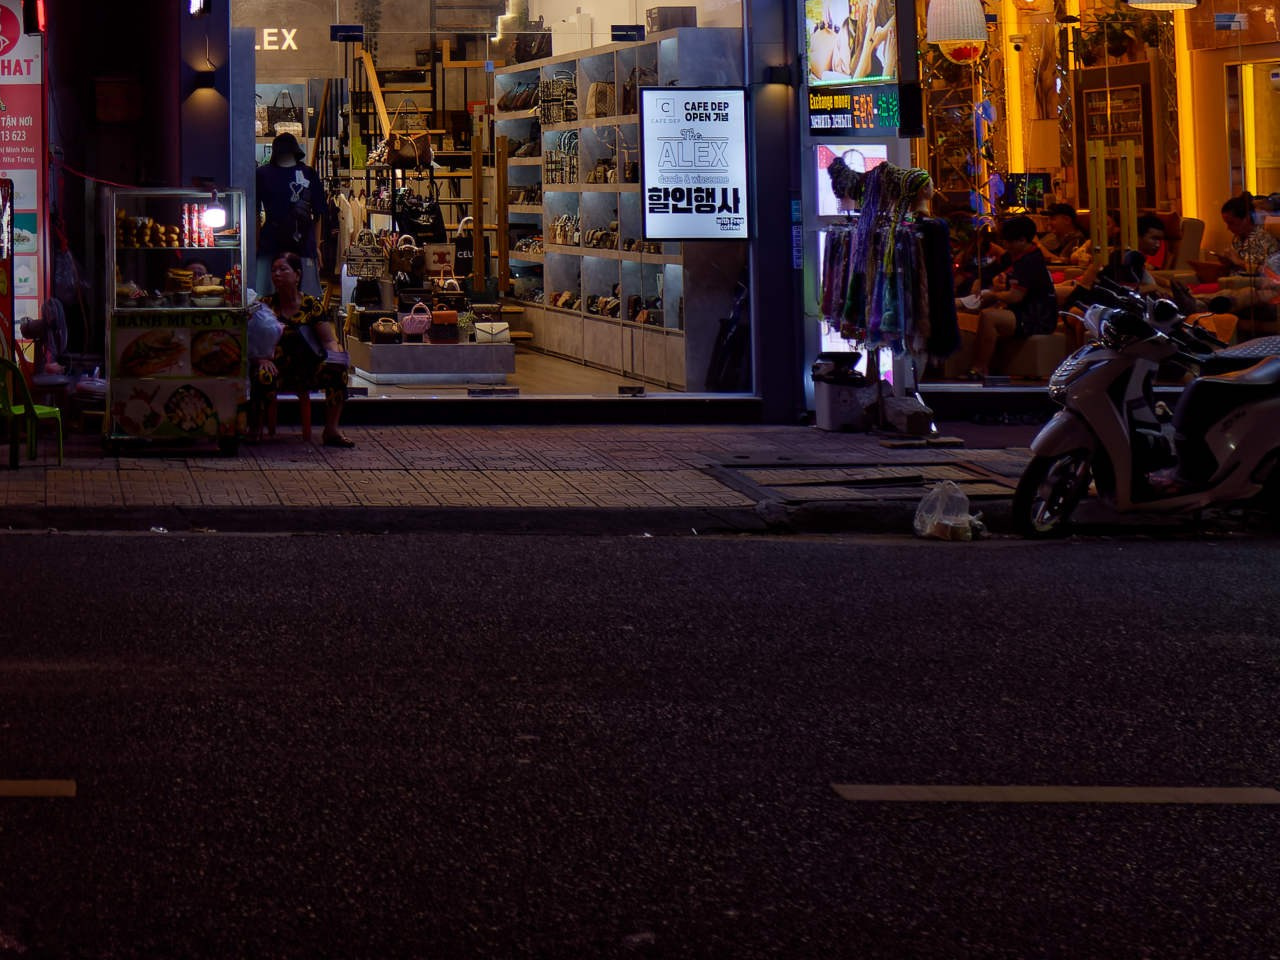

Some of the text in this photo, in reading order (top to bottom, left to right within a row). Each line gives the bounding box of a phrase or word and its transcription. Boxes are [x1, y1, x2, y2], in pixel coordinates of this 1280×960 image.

[684, 101, 729, 112] CAFE DEP
[685, 112, 711, 122] OPEN
[11, 131, 26, 141] 623
[680, 128, 703, 141] The
[658, 141, 729, 168] ALEX
[647, 187, 741, 214] 할인행사
